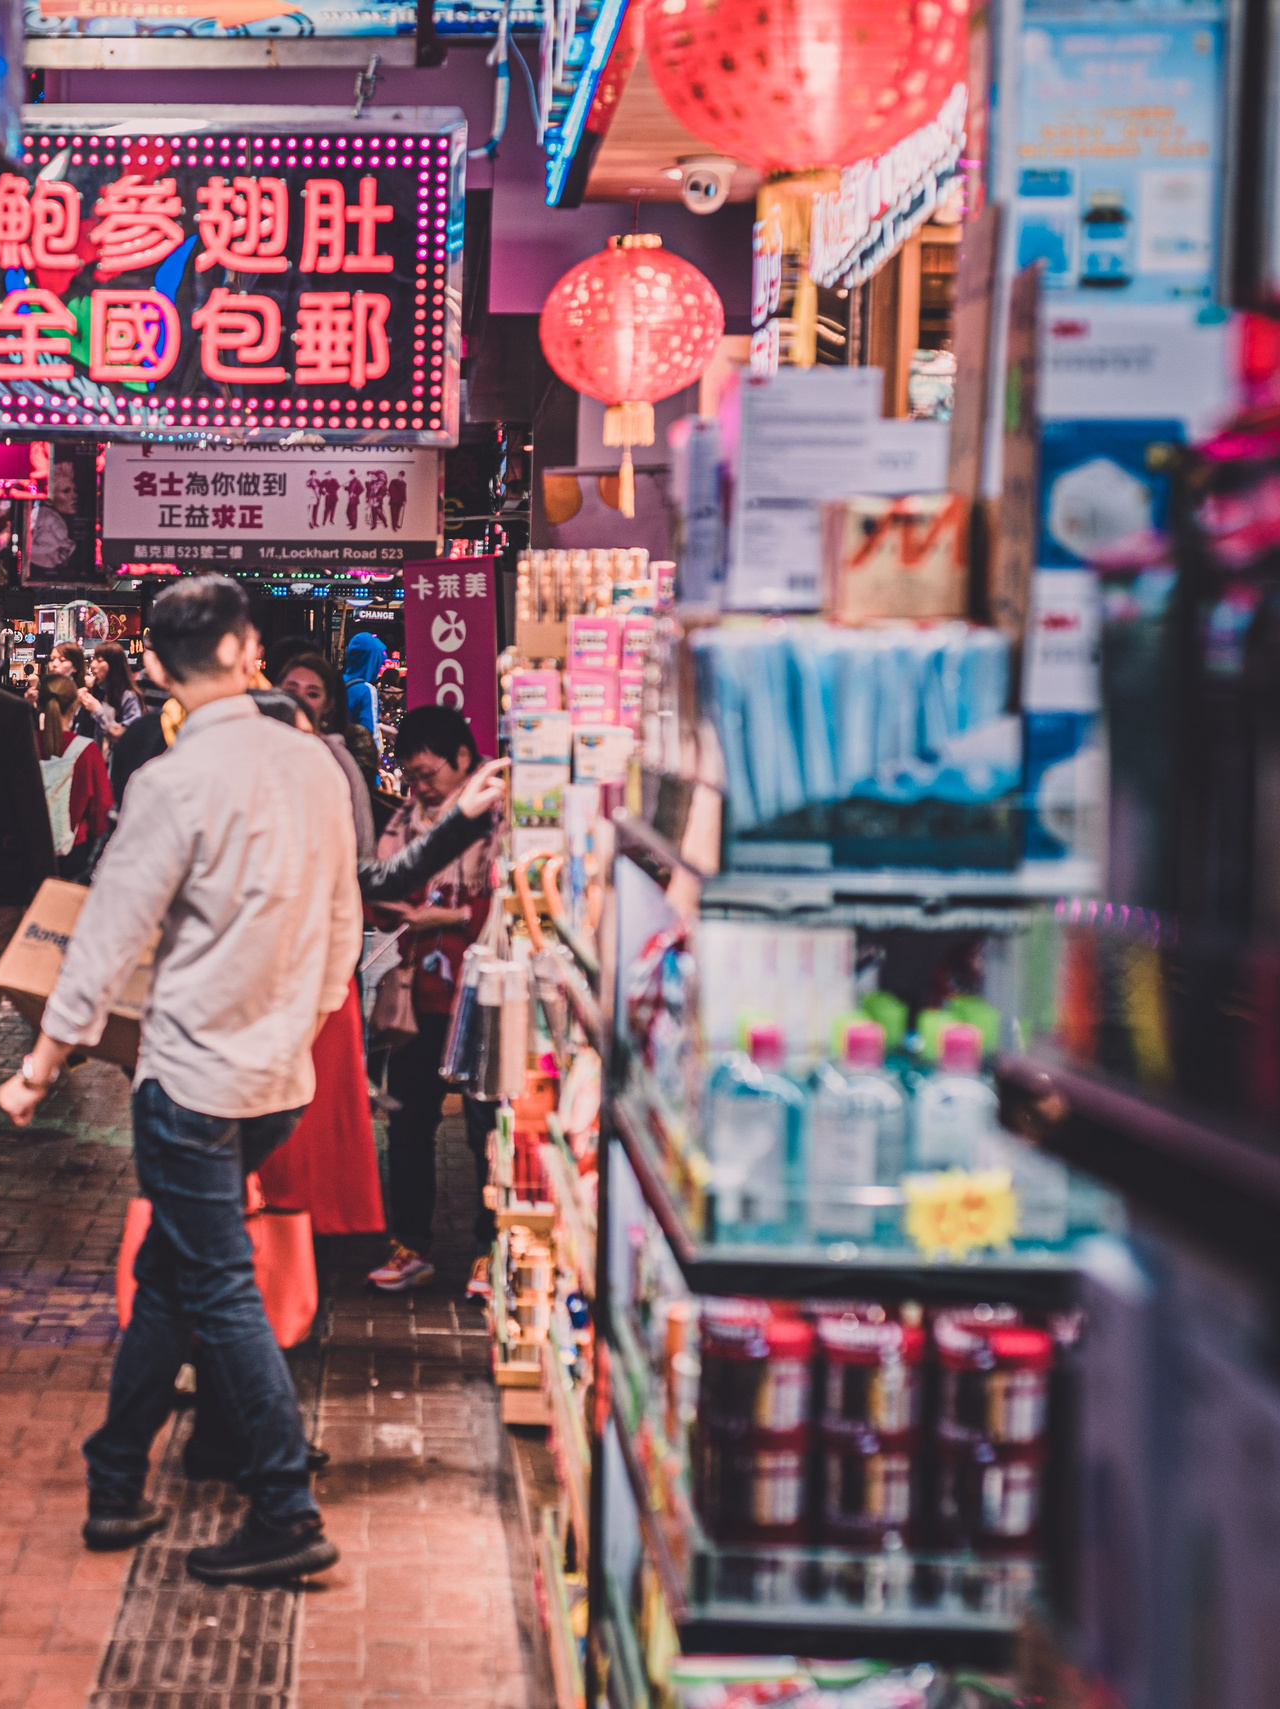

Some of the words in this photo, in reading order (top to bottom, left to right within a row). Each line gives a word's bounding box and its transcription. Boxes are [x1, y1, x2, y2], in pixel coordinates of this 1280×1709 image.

[78, 0, 189, 16] Entrance
[320, 8, 535, 25] www.jdrts.com
[133, 471, 287, 497] 名士為你做到
[158, 504, 264, 529] 正益求正
[343, 548, 377, 560] Road
[381, 549, 404, 560] 523
[410, 572, 488, 601] 卡萊美
[358, 610, 395, 620] CHANGE
